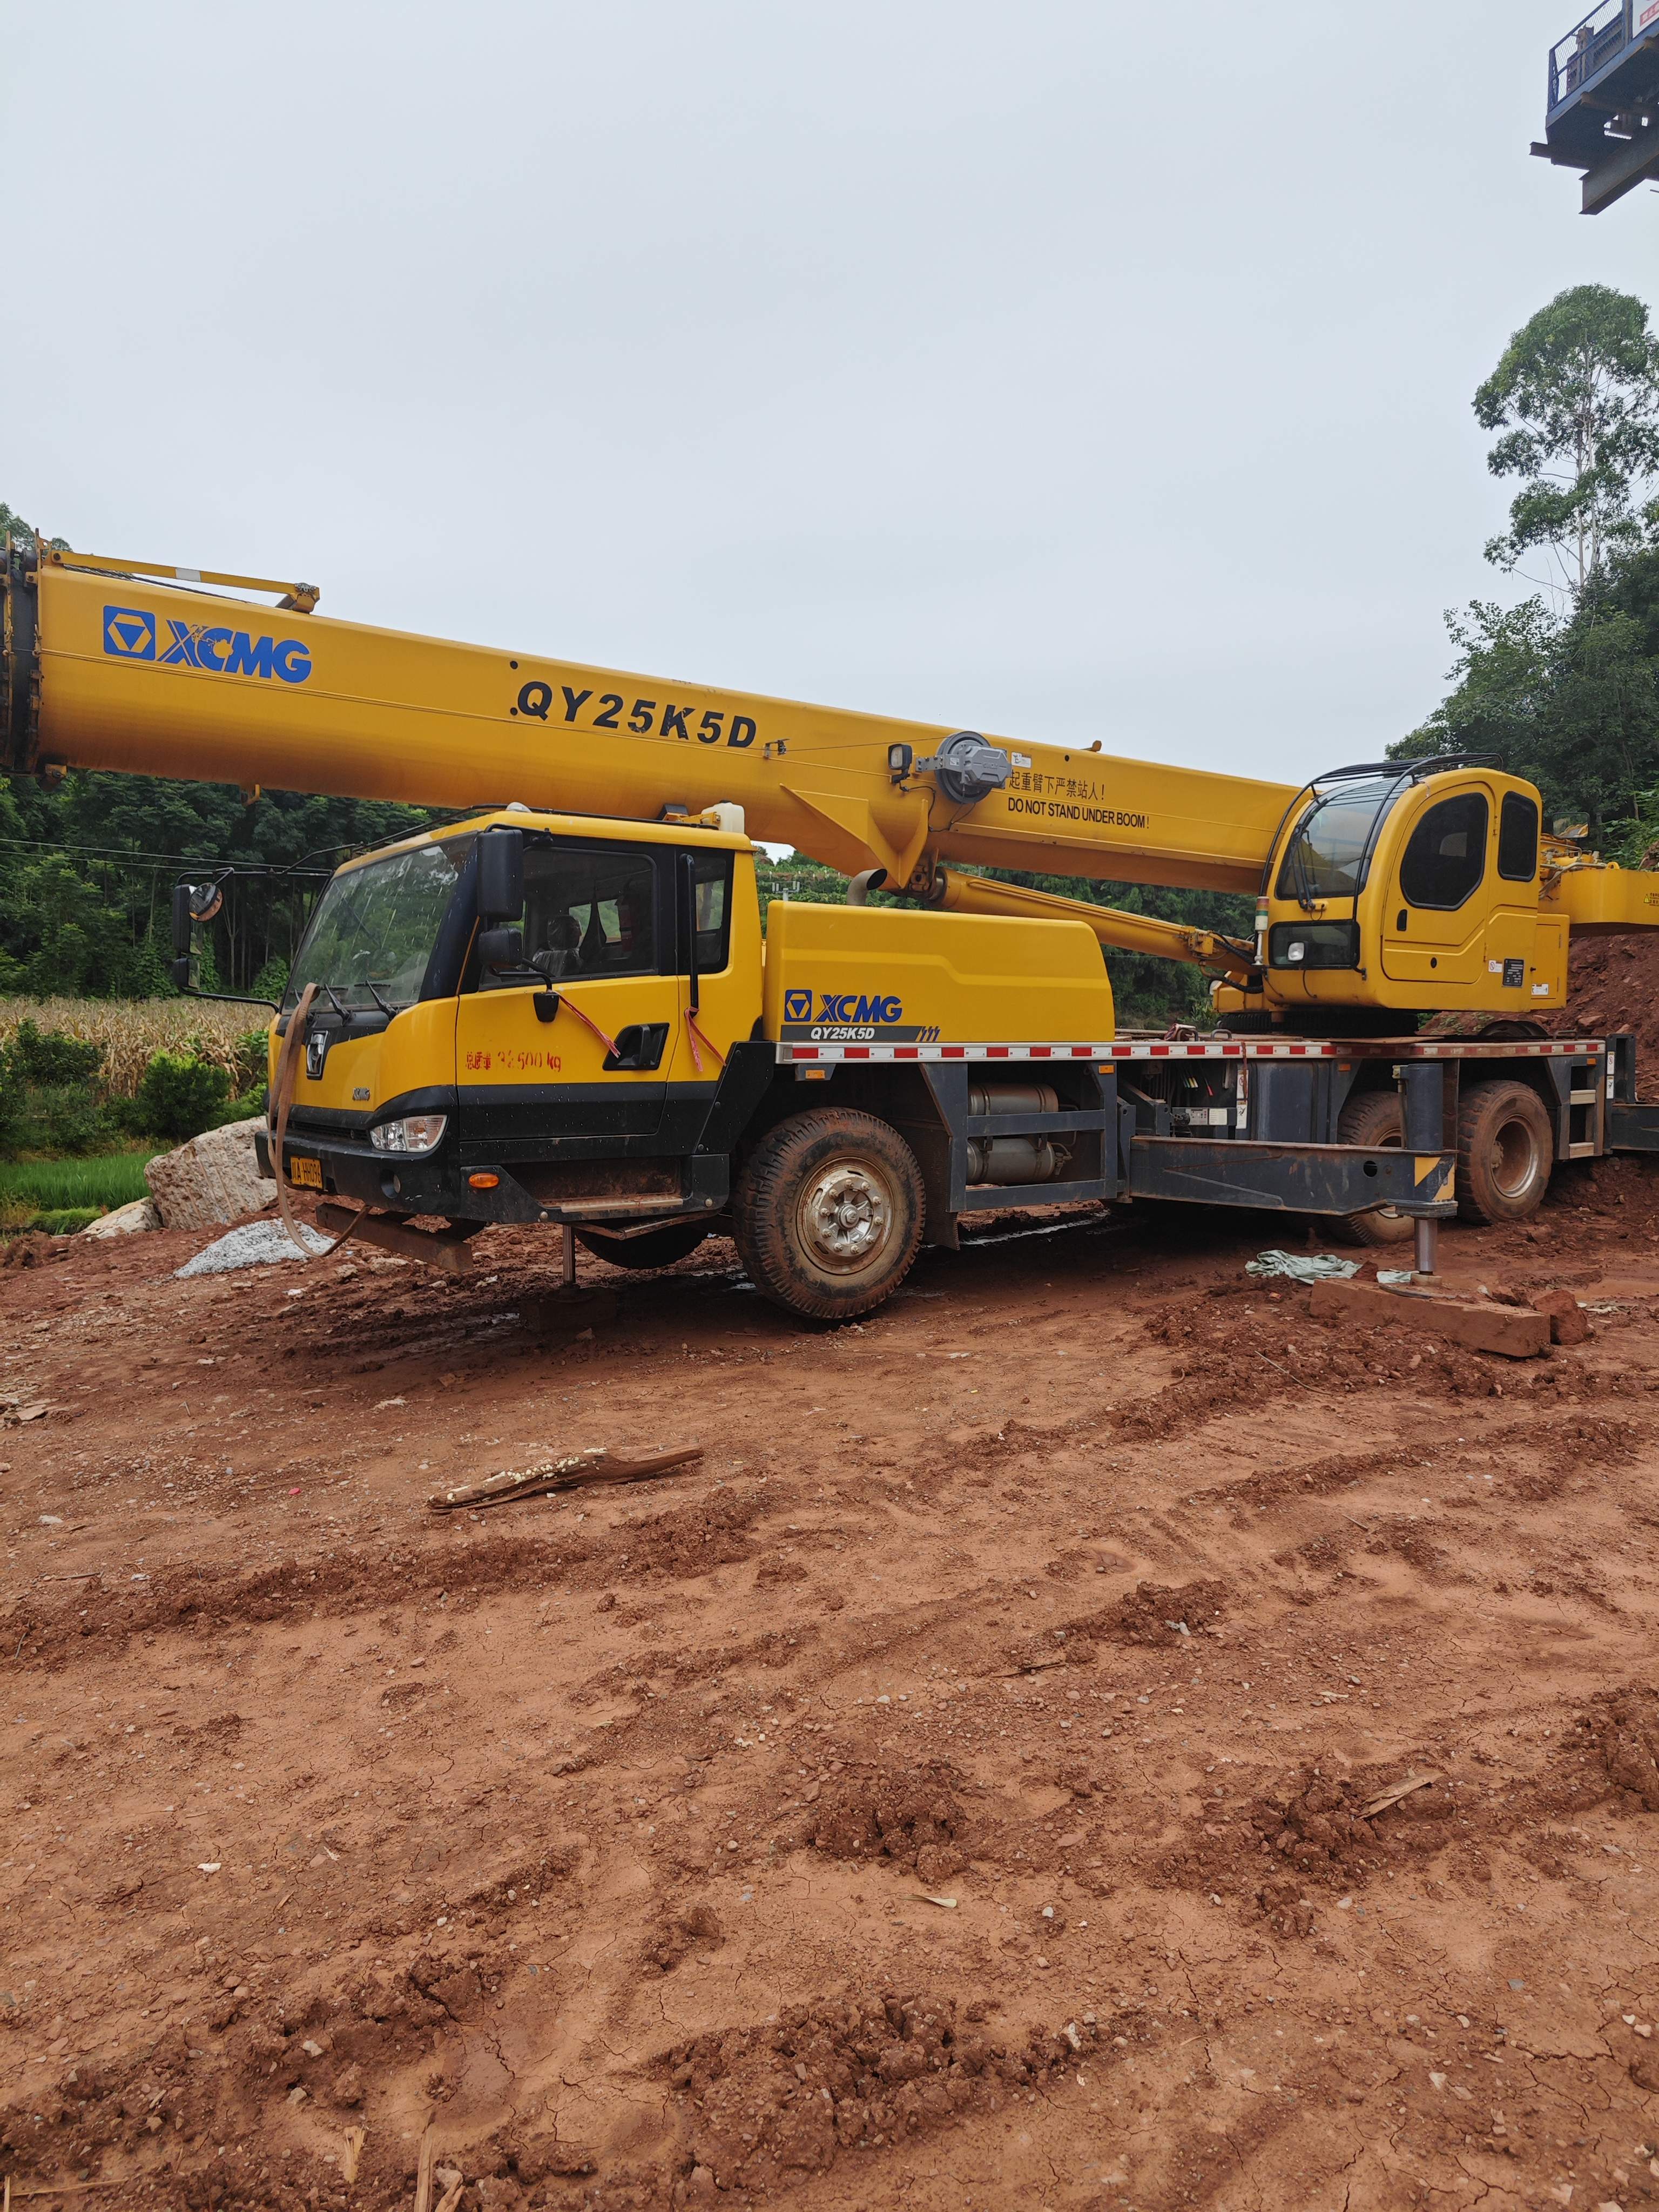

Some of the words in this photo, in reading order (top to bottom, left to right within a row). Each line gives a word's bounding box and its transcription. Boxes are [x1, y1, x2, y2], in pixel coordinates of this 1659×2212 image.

[157, 619, 312, 683] XCMG
[517, 681, 756, 748] QY25K5D
[1009, 769, 1105, 800] 起重臂下严禁站人!
[1008, 797, 1024, 813] DO
[1026, 799, 1047, 815] NOT
[1048, 802, 1081, 820] STAND
[1082, 807, 1115, 825] UNDER
[813, 994, 902, 1023] XCMG
[810, 1027, 875, 1040] QY25K5D
[547, 1051, 561, 1073] kg
